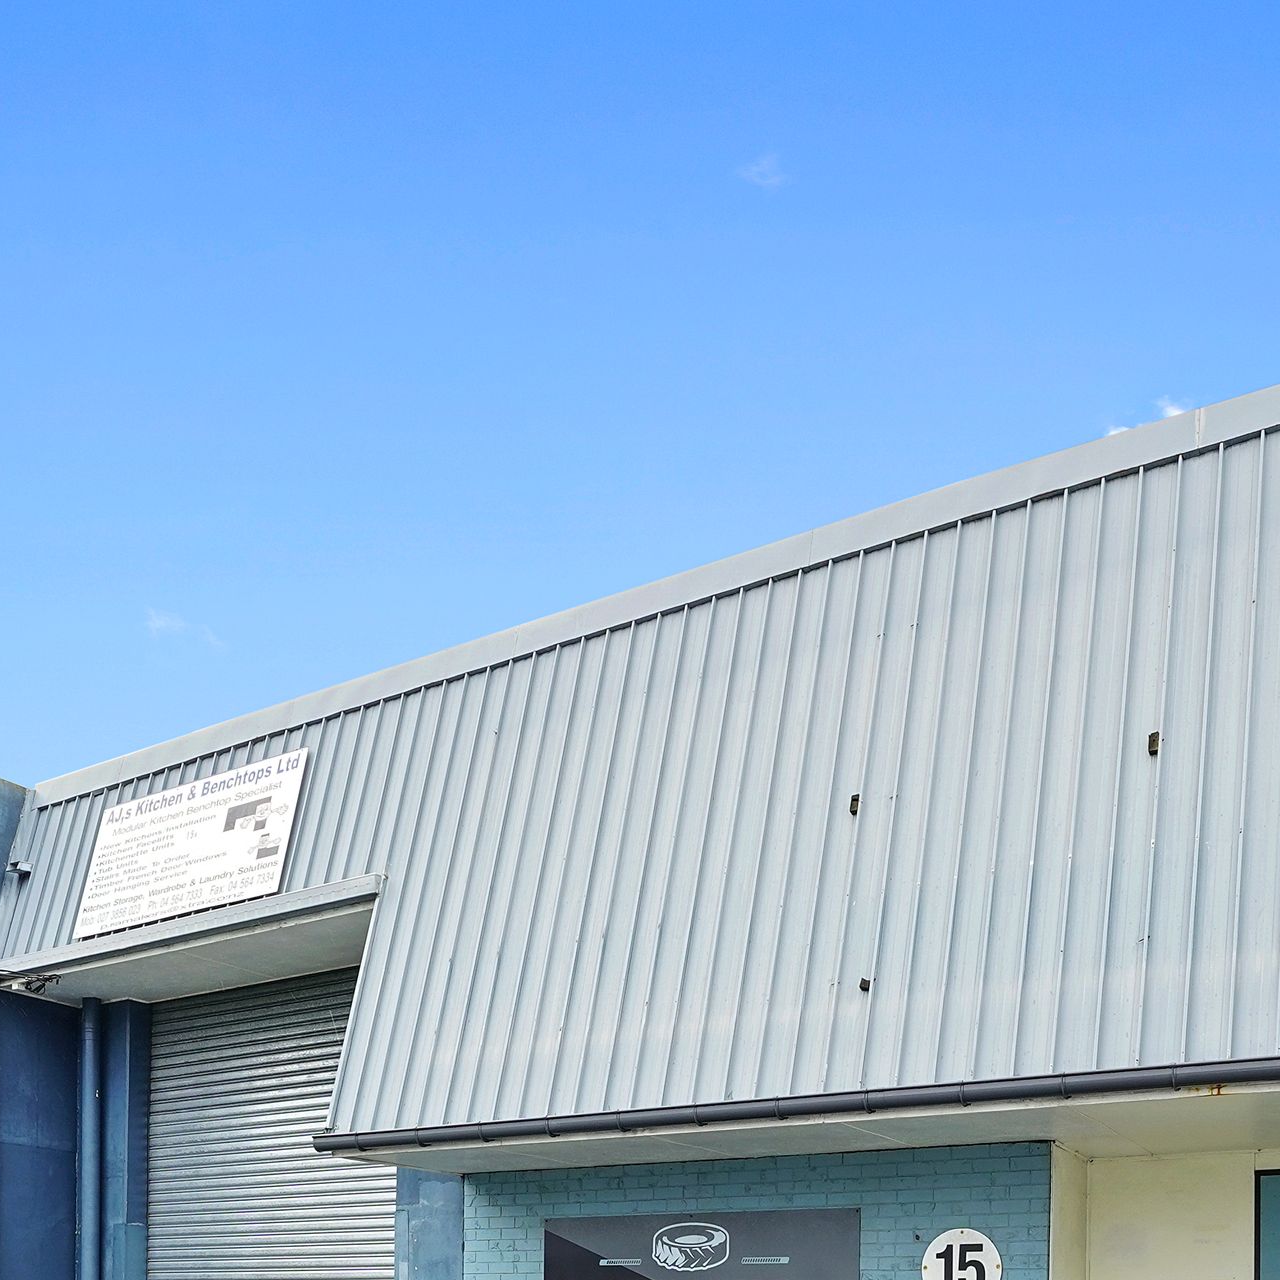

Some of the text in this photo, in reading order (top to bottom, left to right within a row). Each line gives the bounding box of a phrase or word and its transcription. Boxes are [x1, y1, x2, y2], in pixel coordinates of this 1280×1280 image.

[135, 792, 182, 816] Kitchen
[187, 785, 196, 800] &
[200, 765, 272, 797] Benchtops
[276, 753, 300, 774] Ltd
[112, 780, 281, 836] Modular Kitchen Benchtop Specialist
[99, 842, 174, 866] Kitchenette Units
[101, 834, 173, 858] Kitchen Facelifts
[95, 873, 119, 882] Stairs
[123, 865, 147, 874] Made
[163, 853, 189, 863] Order
[116, 860, 137, 869] Units
[82, 860, 278, 913] Kitchen Storage, Wardrobe & Laundry Solutions
[91, 870, 187, 898] Door Hanging Service
[94, 879, 122, 889] Timber
[127, 870, 156, 881] French
